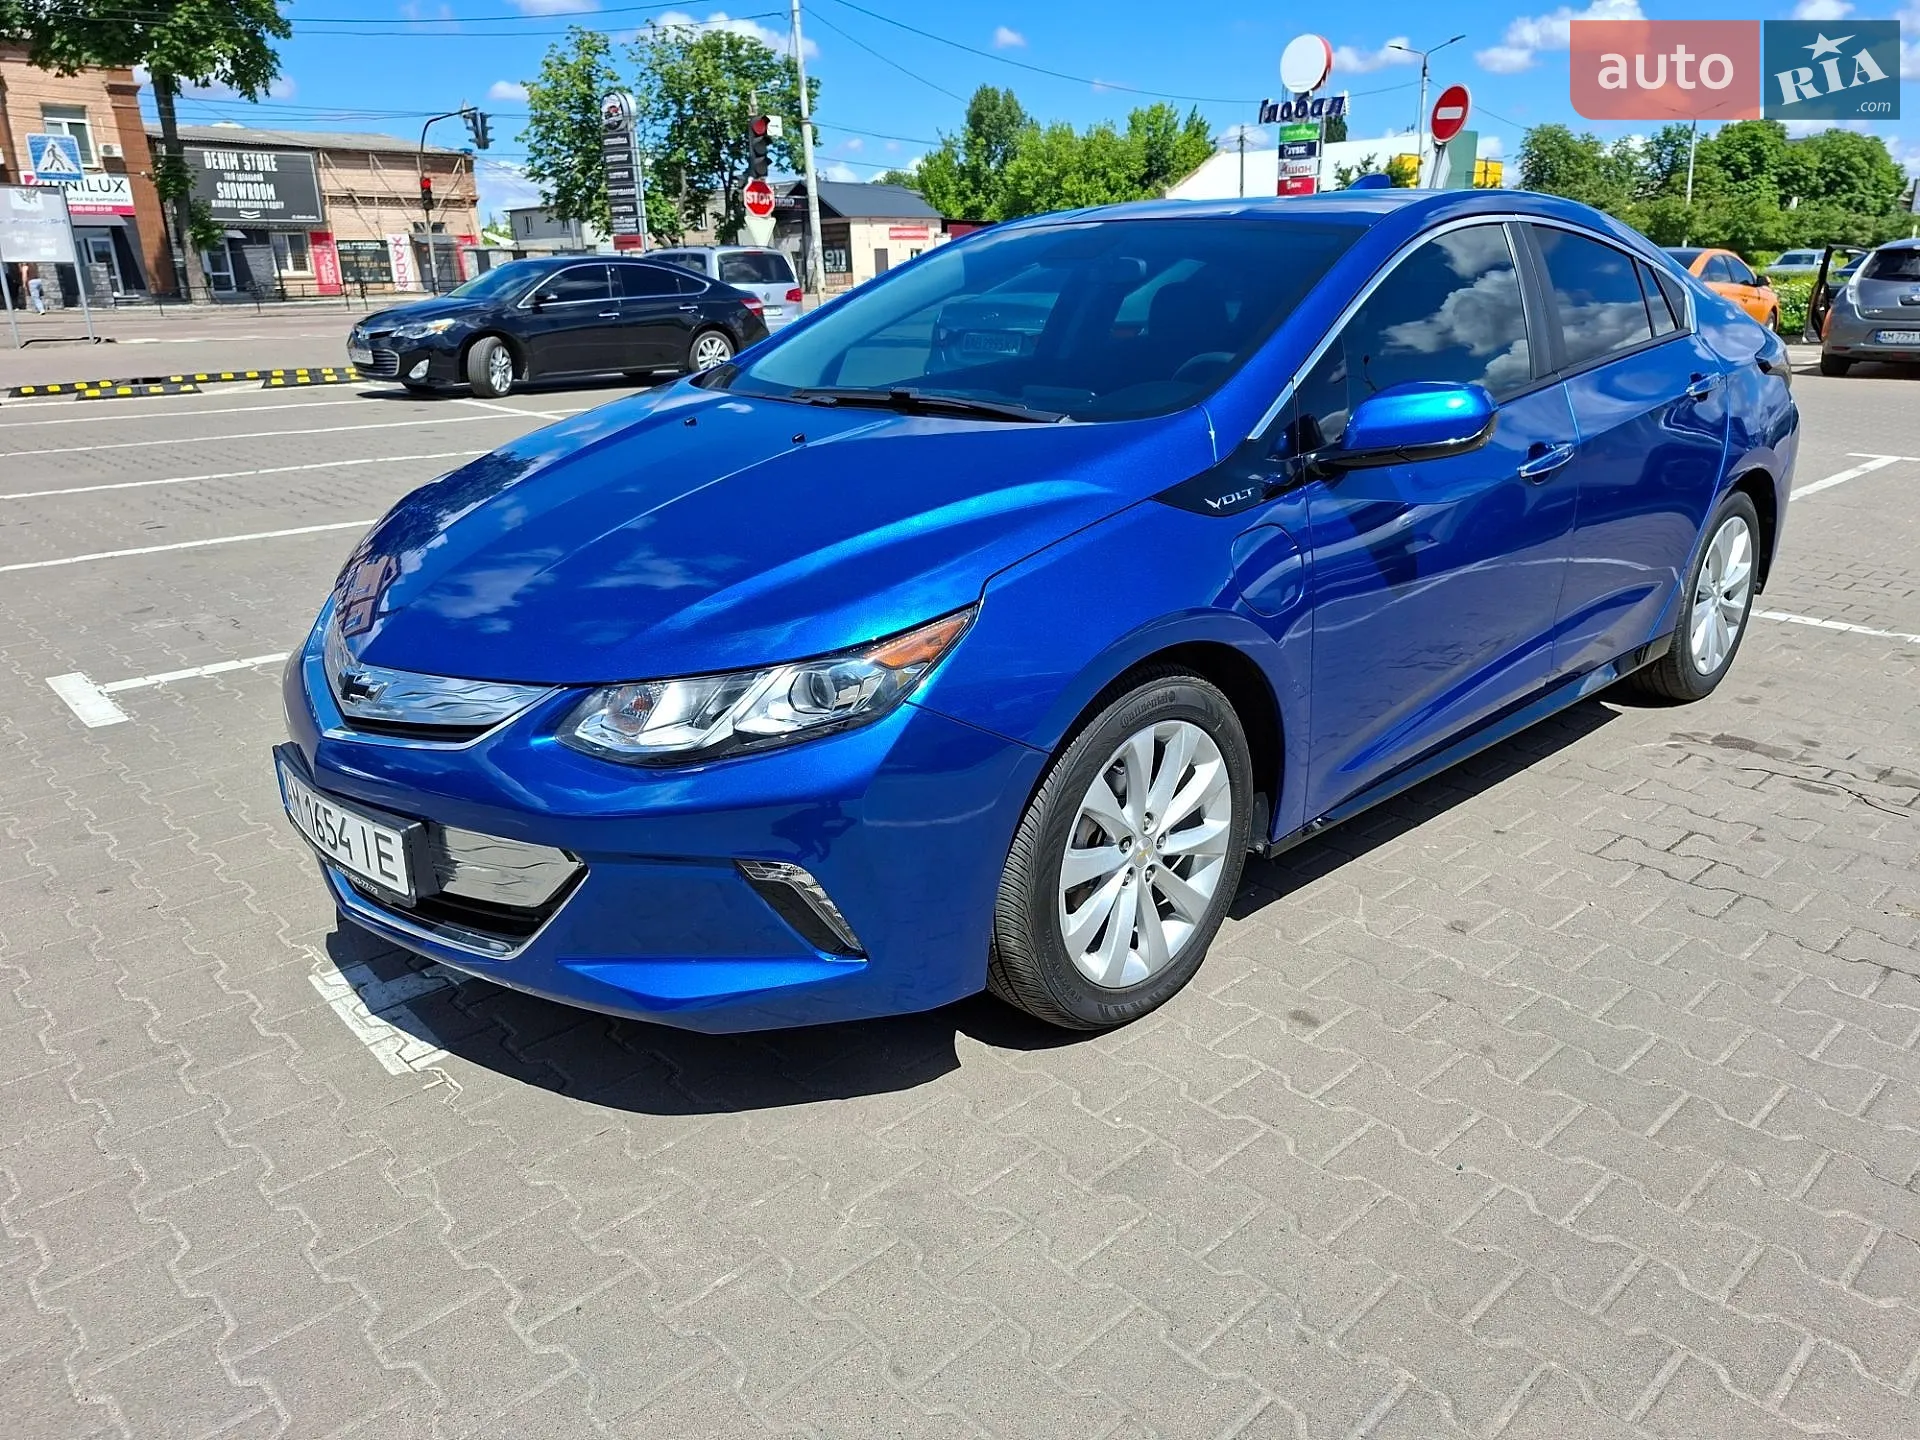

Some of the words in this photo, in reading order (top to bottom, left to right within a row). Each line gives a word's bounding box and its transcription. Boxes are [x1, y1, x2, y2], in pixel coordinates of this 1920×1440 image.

[203, 151, 240, 170] DENIM
[242, 153, 279, 172] STORE
[216, 181, 277, 200] SHOWROOM
[745, 190, 773, 206] STOP
[824, 249, 846, 266] 911
[1204, 487, 1255, 510] VOLT
[305, 793, 353, 862] 1654
[360, 824, 399, 883] IE
